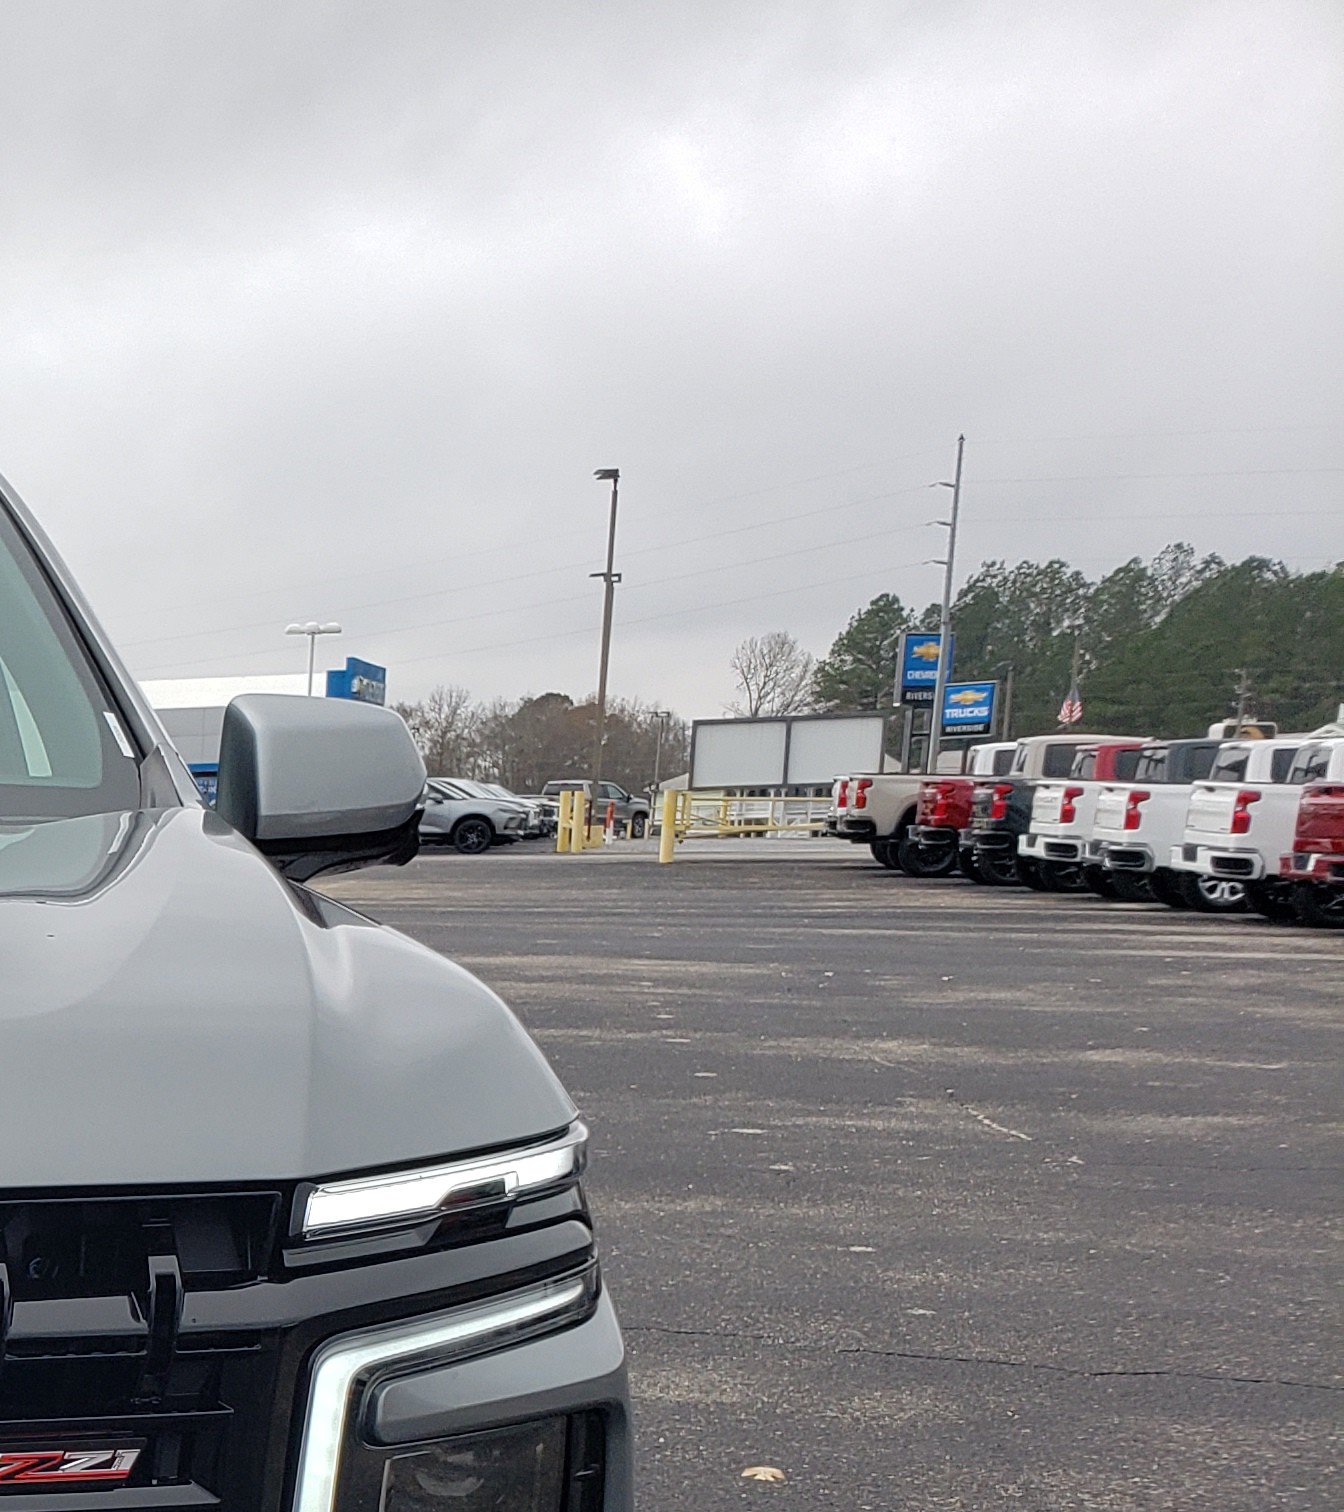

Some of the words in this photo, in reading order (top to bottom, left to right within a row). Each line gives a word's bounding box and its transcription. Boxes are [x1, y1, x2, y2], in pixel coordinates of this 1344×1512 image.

[907, 670, 949, 680] CHEVRO
[905, 691, 935, 701] RIVERS
[945, 706, 989, 719] TRUCKS
[945, 724, 985, 733] RIVERSIDE
